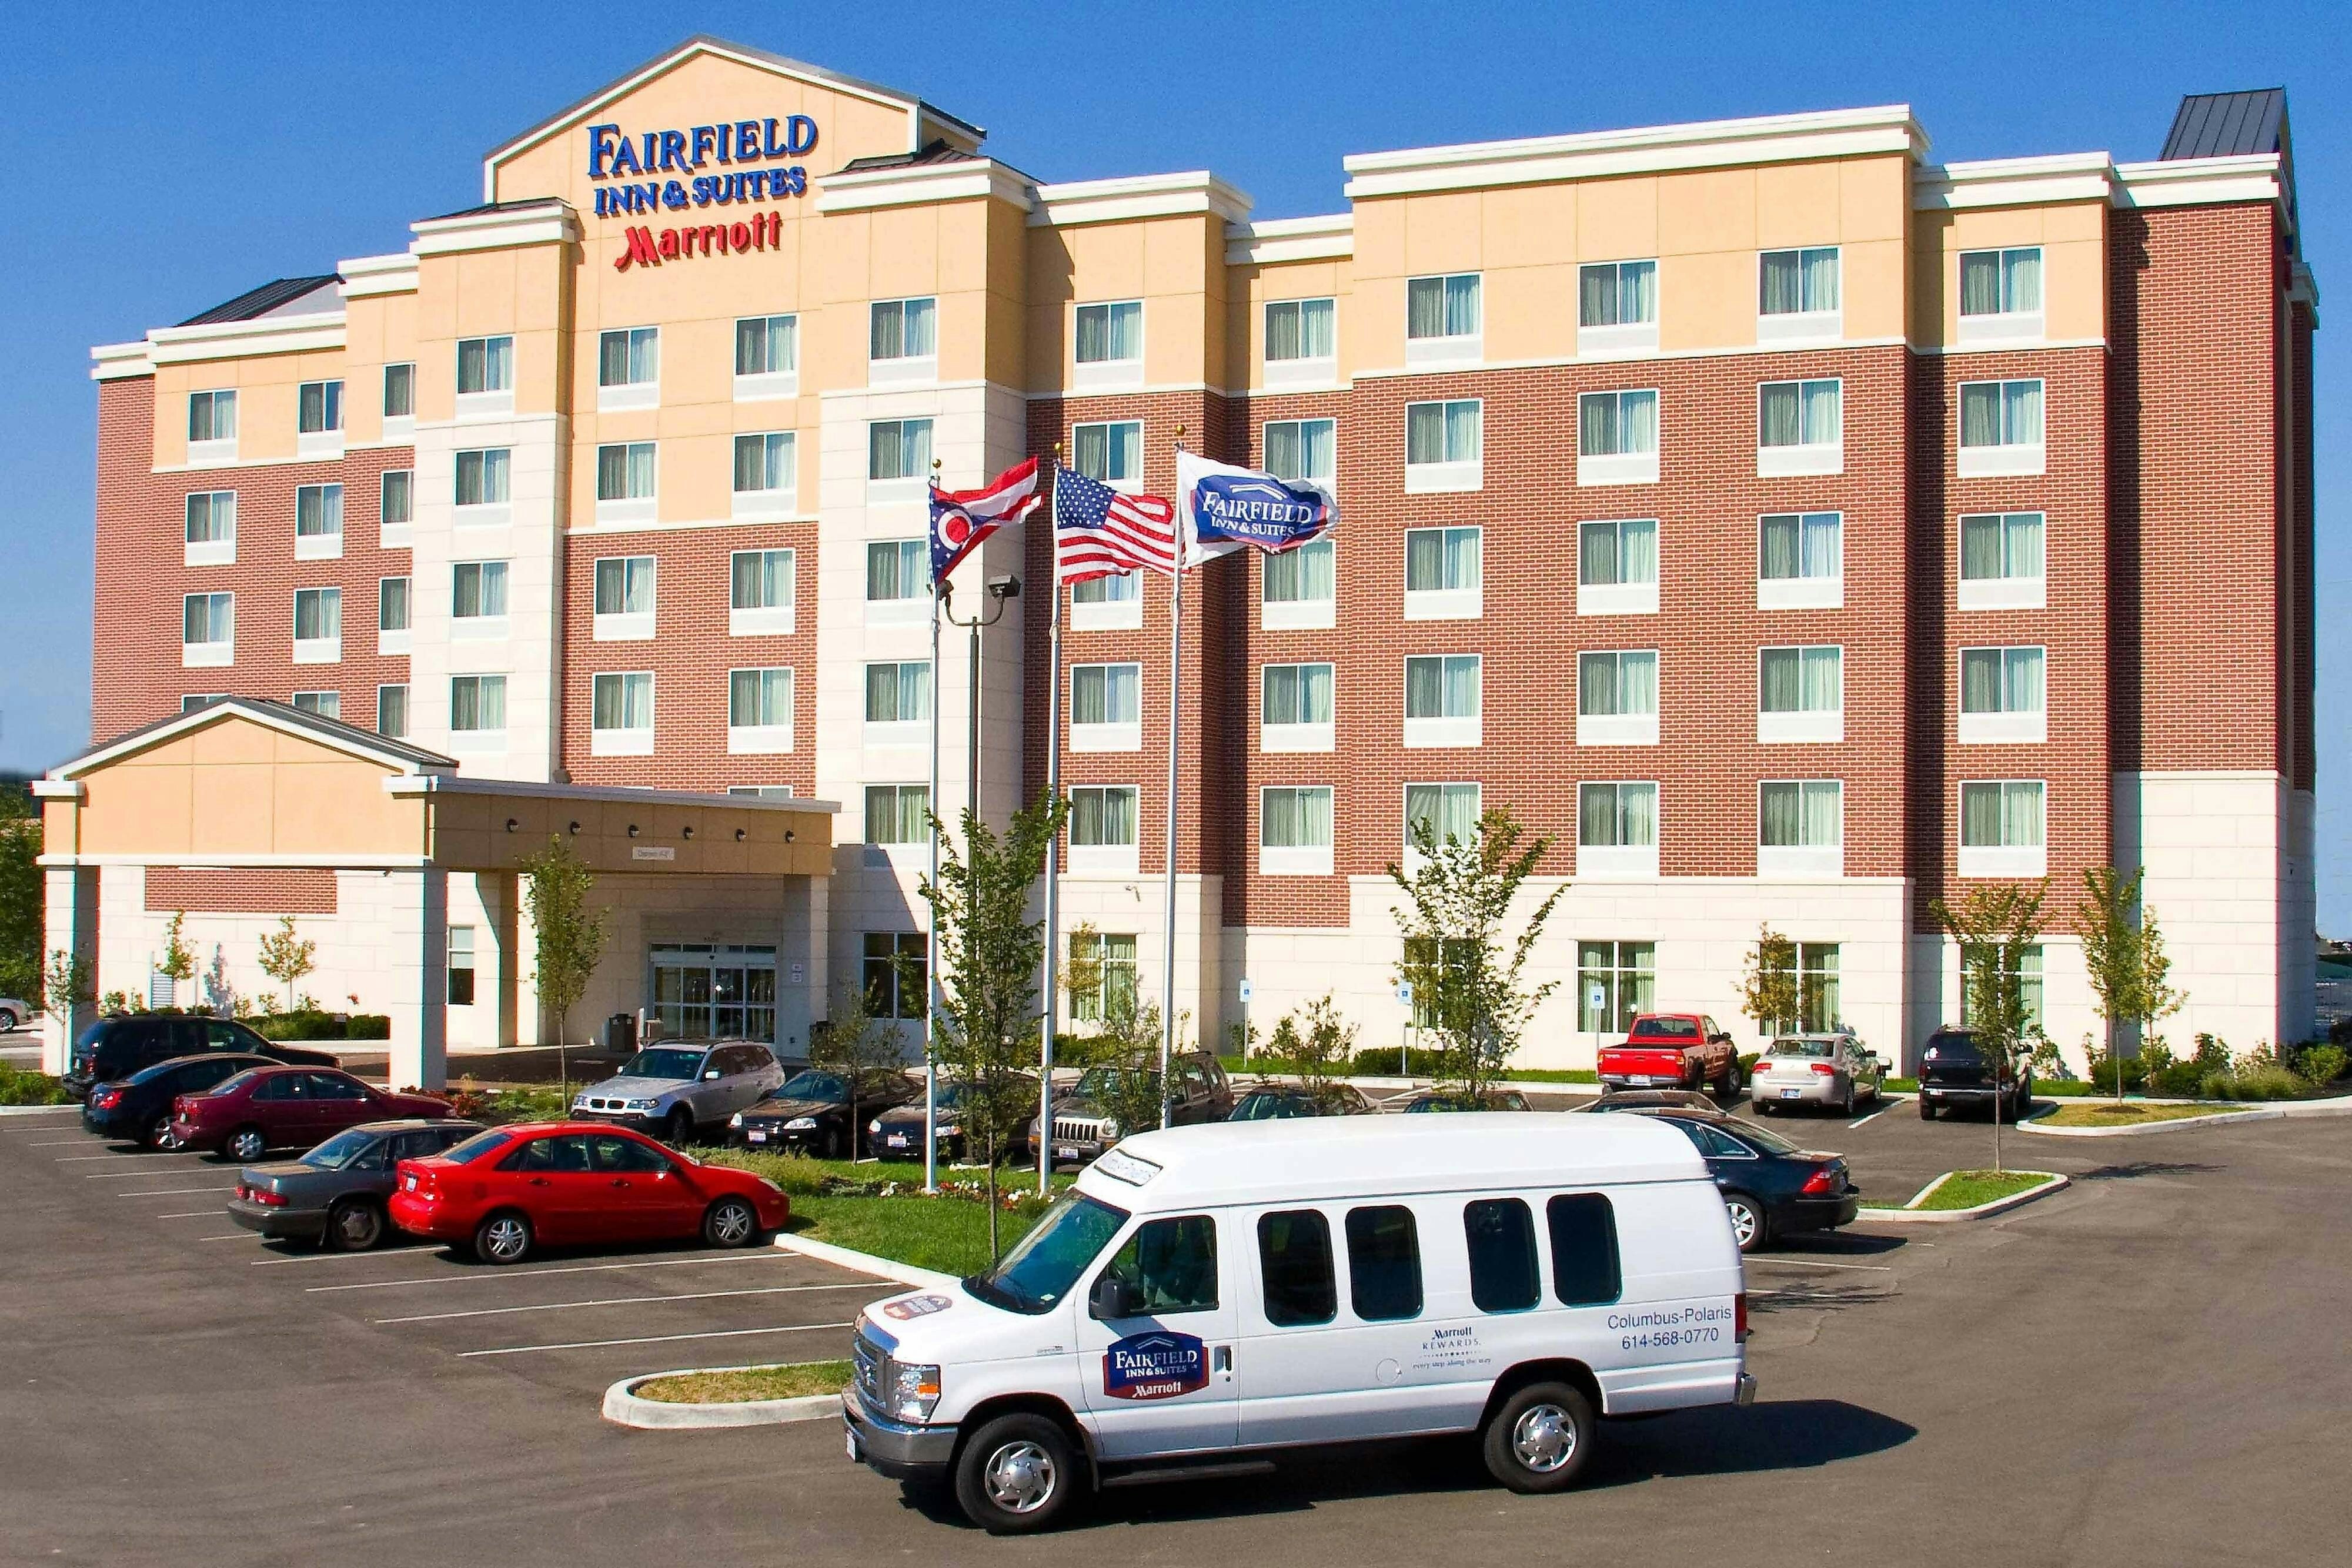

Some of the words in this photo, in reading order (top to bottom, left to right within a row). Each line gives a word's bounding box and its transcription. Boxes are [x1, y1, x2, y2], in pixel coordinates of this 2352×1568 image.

[586, 114, 818, 179] FAIRFIELD
[614, 210, 783, 272] Marriott
[1202, 490, 1313, 525] FAIRFIELD
[1607, 1305, 1732, 1330] Columbus-Polaris
[1431, 1326, 1472, 1340] Marriott
[1622, 1327, 1719, 1349] 614-568-0770
[1115, 1350, 1198, 1369] FAIRFIELD
[1132, 1380, 1181, 1398] Marriott
